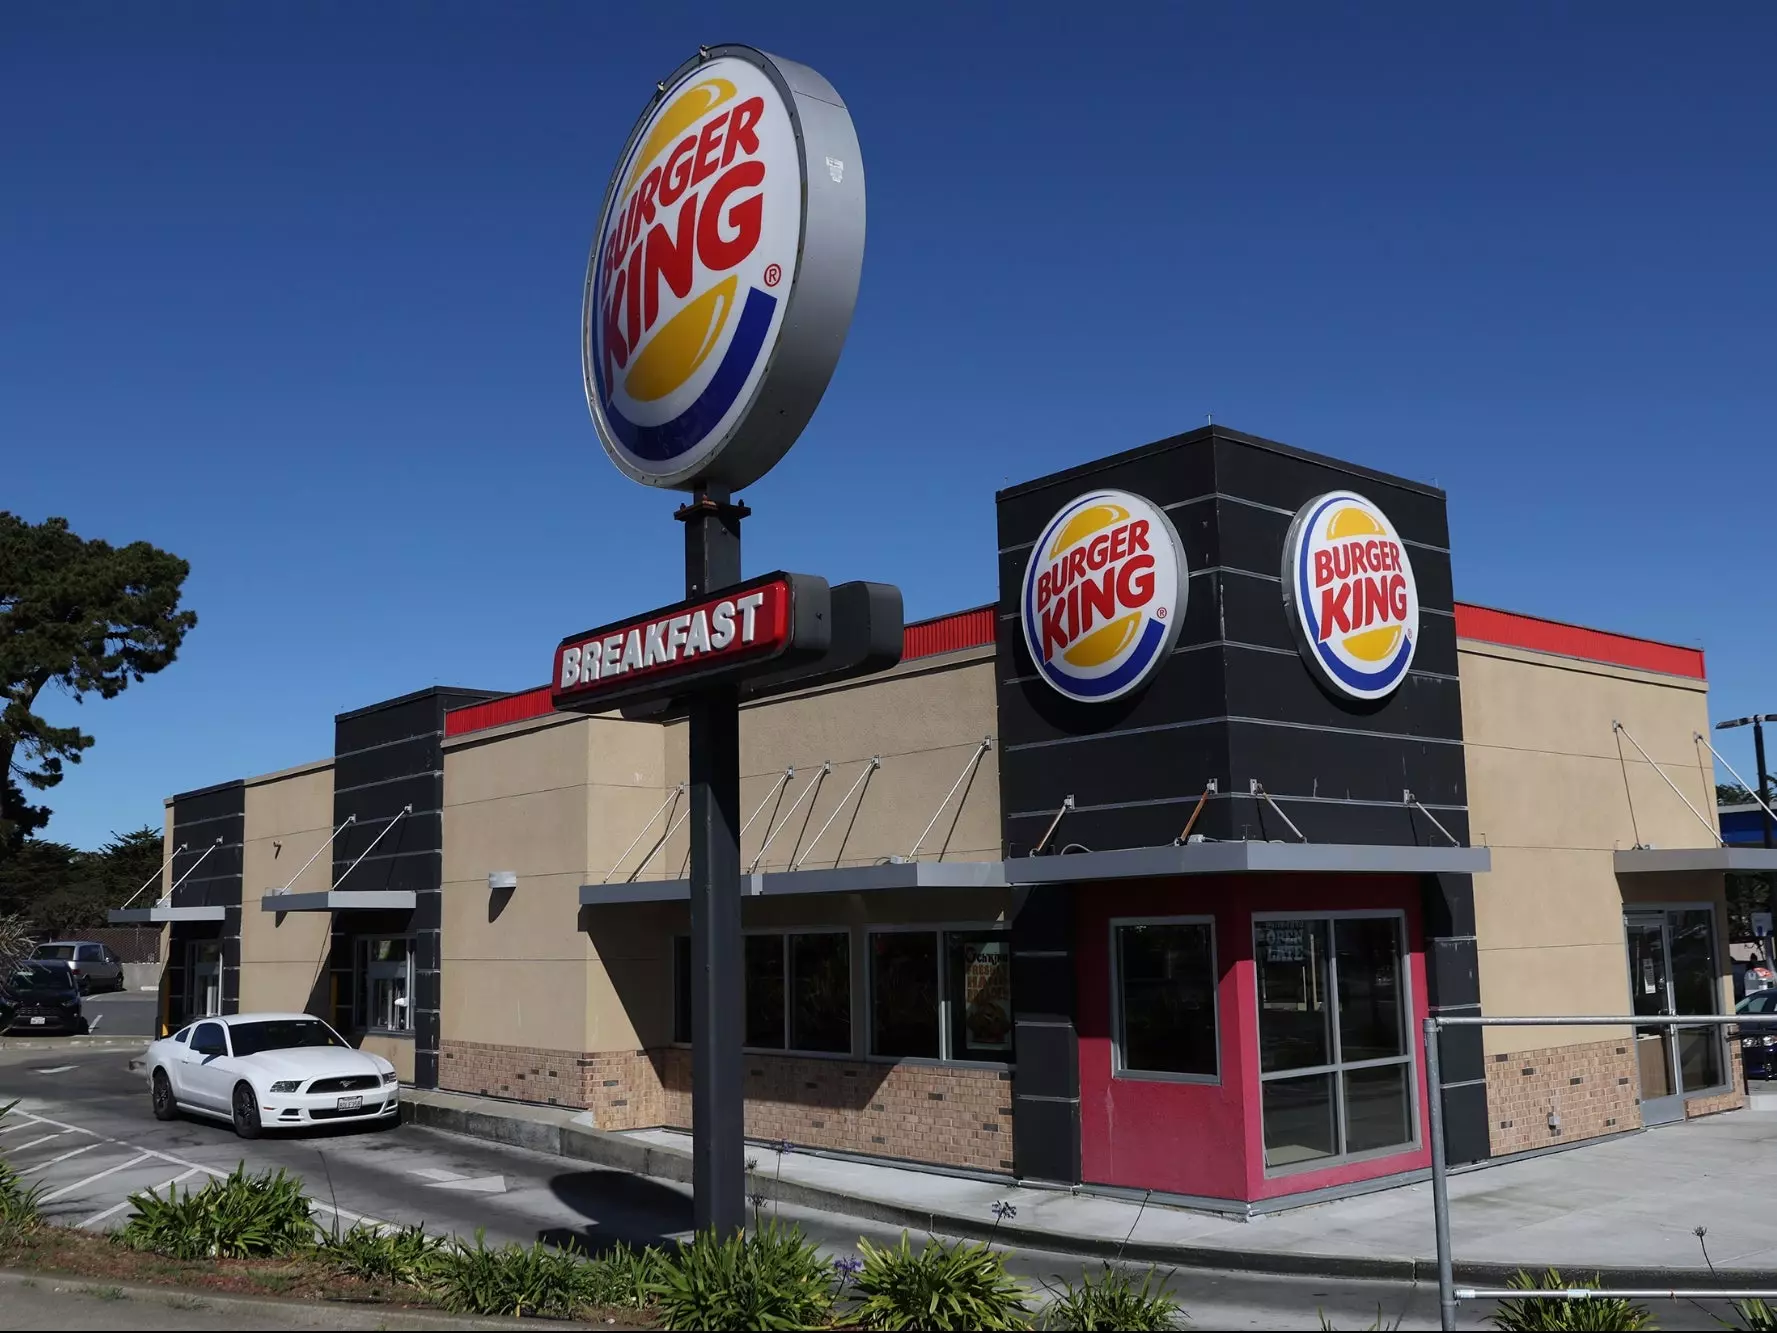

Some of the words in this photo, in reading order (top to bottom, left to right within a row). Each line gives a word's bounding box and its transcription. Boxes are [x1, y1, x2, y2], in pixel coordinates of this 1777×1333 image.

[602, 96, 765, 311] BURGER
[603, 160, 765, 406] KING
[1037, 519, 1150, 614] BURGER
[1041, 554, 1155, 663] KING
[1314, 540, 1402, 588] BURGER
[1318, 574, 1407, 644] KING
[560, 592, 764, 689] BREAKFAST
